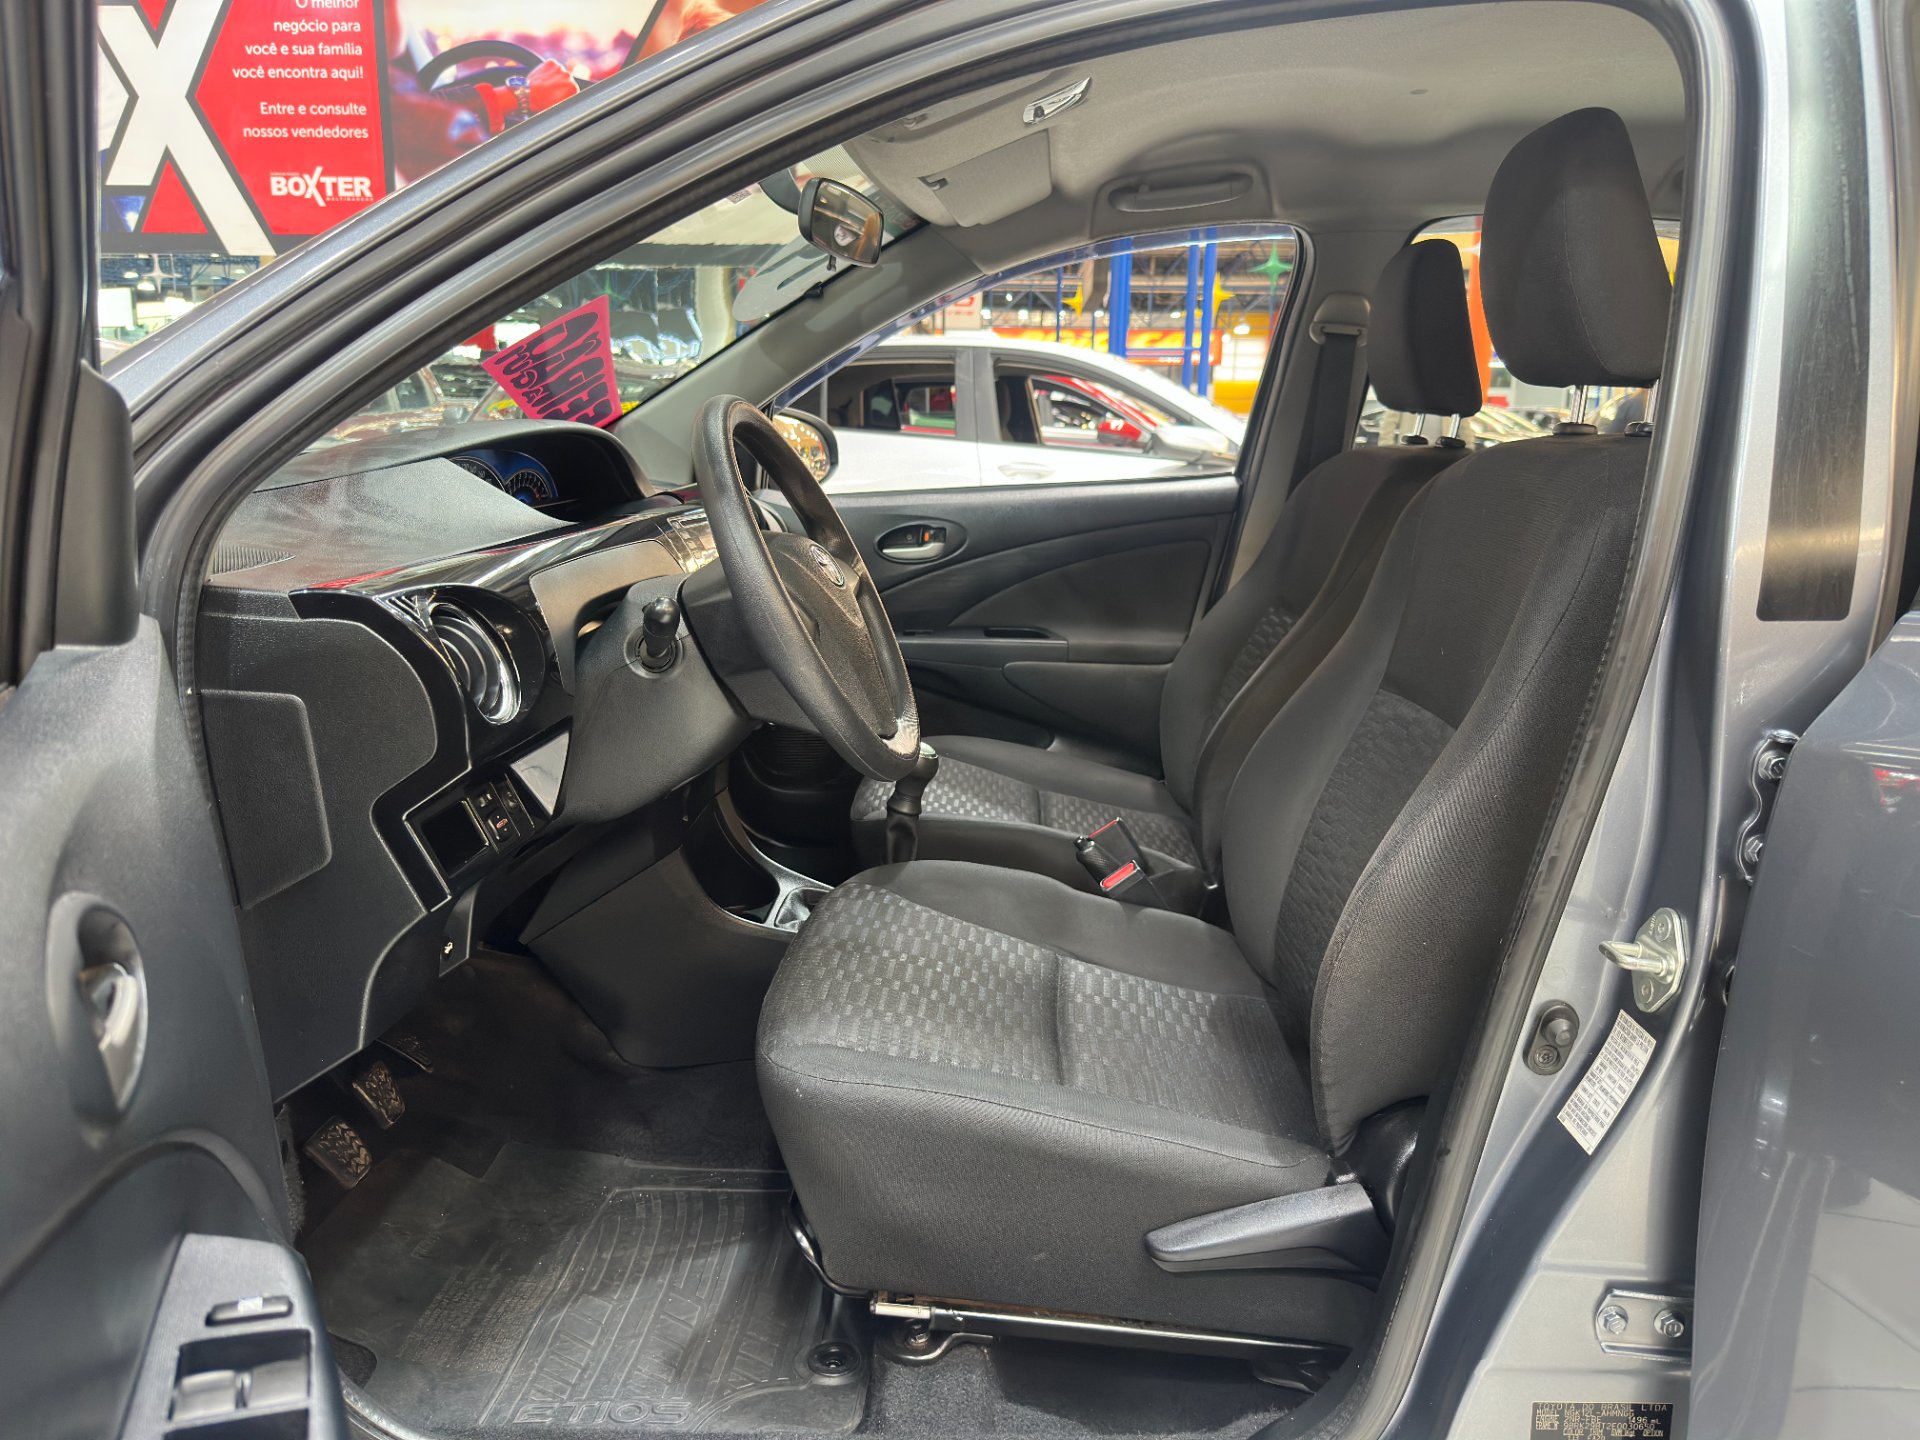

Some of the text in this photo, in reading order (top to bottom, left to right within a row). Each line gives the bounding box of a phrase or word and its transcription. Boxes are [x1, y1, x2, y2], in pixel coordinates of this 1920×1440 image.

[273, 19, 361, 35] negócio para
[245, 43, 363, 56] você e sua família
[232, 65, 364, 80] você encontra aqui!
[260, 102, 367, 116] Entre e consulte
[243, 125, 369, 139] nossos vendedores
[270, 166, 373, 207] BOXTER
[513, 1401, 692, 1424] ETIOS
